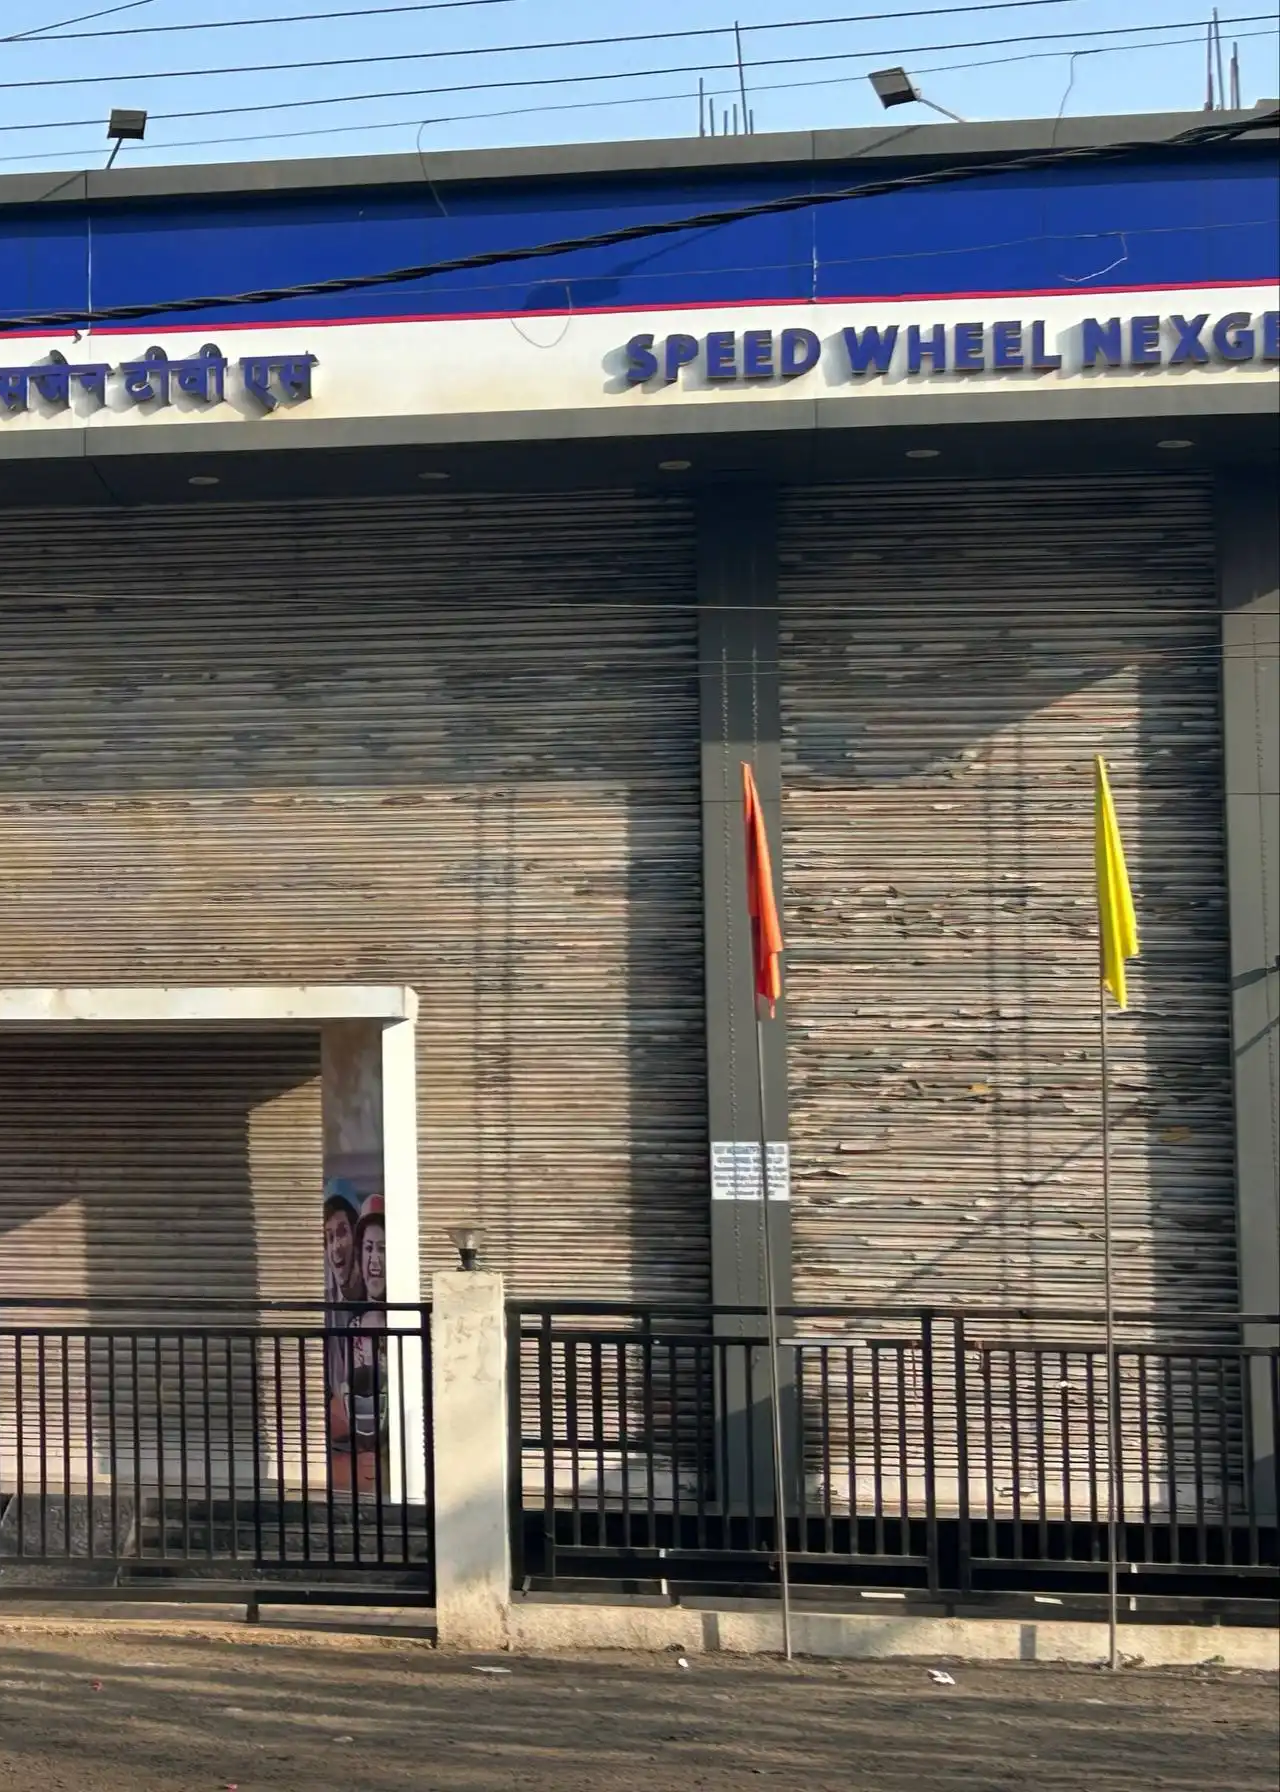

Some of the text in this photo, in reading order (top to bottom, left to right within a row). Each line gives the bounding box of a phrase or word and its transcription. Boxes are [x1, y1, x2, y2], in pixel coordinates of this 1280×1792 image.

[119, 343, 228, 406] टीवी
[239, 352, 319, 415] एस
[626, 327, 821, 385] SPEED
[842, 320, 1062, 377] WHEEL
